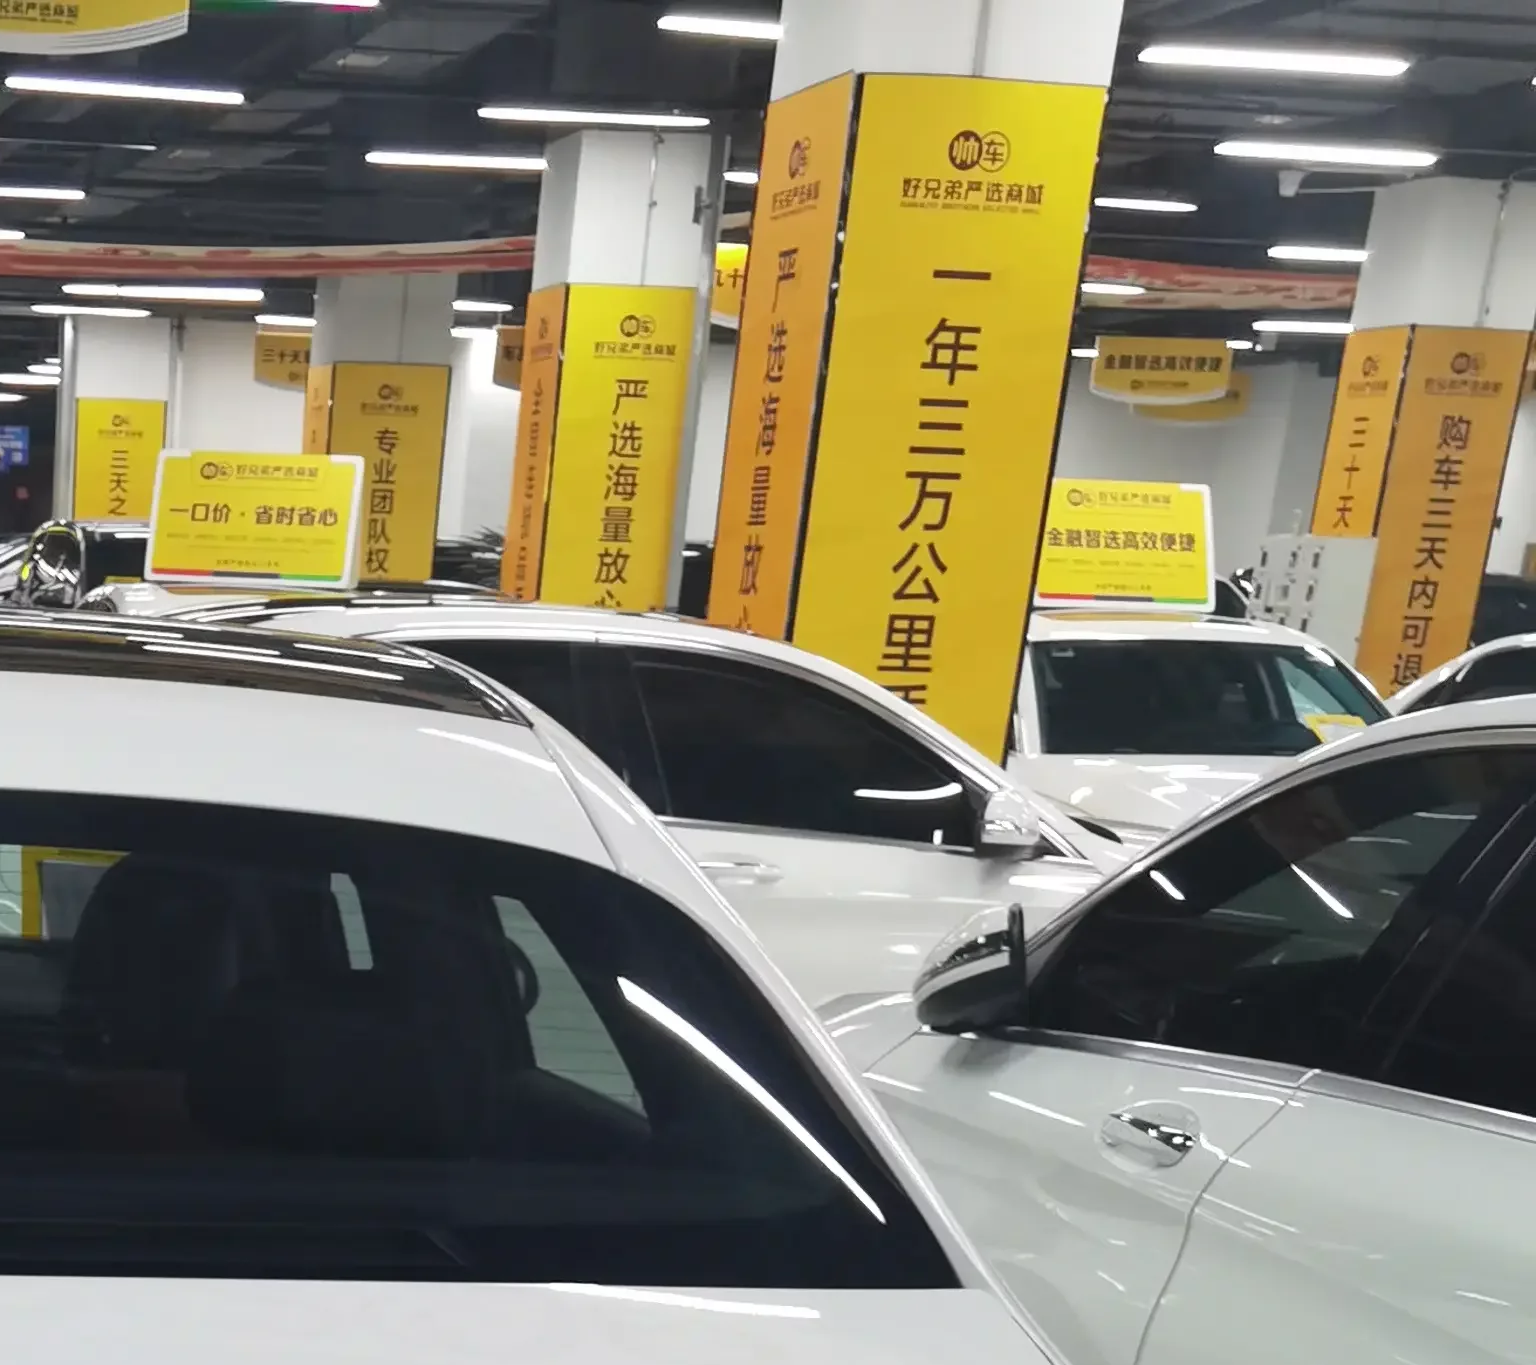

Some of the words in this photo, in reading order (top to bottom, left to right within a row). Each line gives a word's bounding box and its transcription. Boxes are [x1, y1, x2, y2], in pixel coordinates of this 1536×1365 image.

[902, 177, 1045, 206] 好兄弟严选商城
[261, 348, 311, 365] 三十天
[108, 449, 130, 516] 三天之
[1047, 526, 1197, 553] 金融智选高效便捷
[1389, 414, 1473, 698] 购车三天内可退
